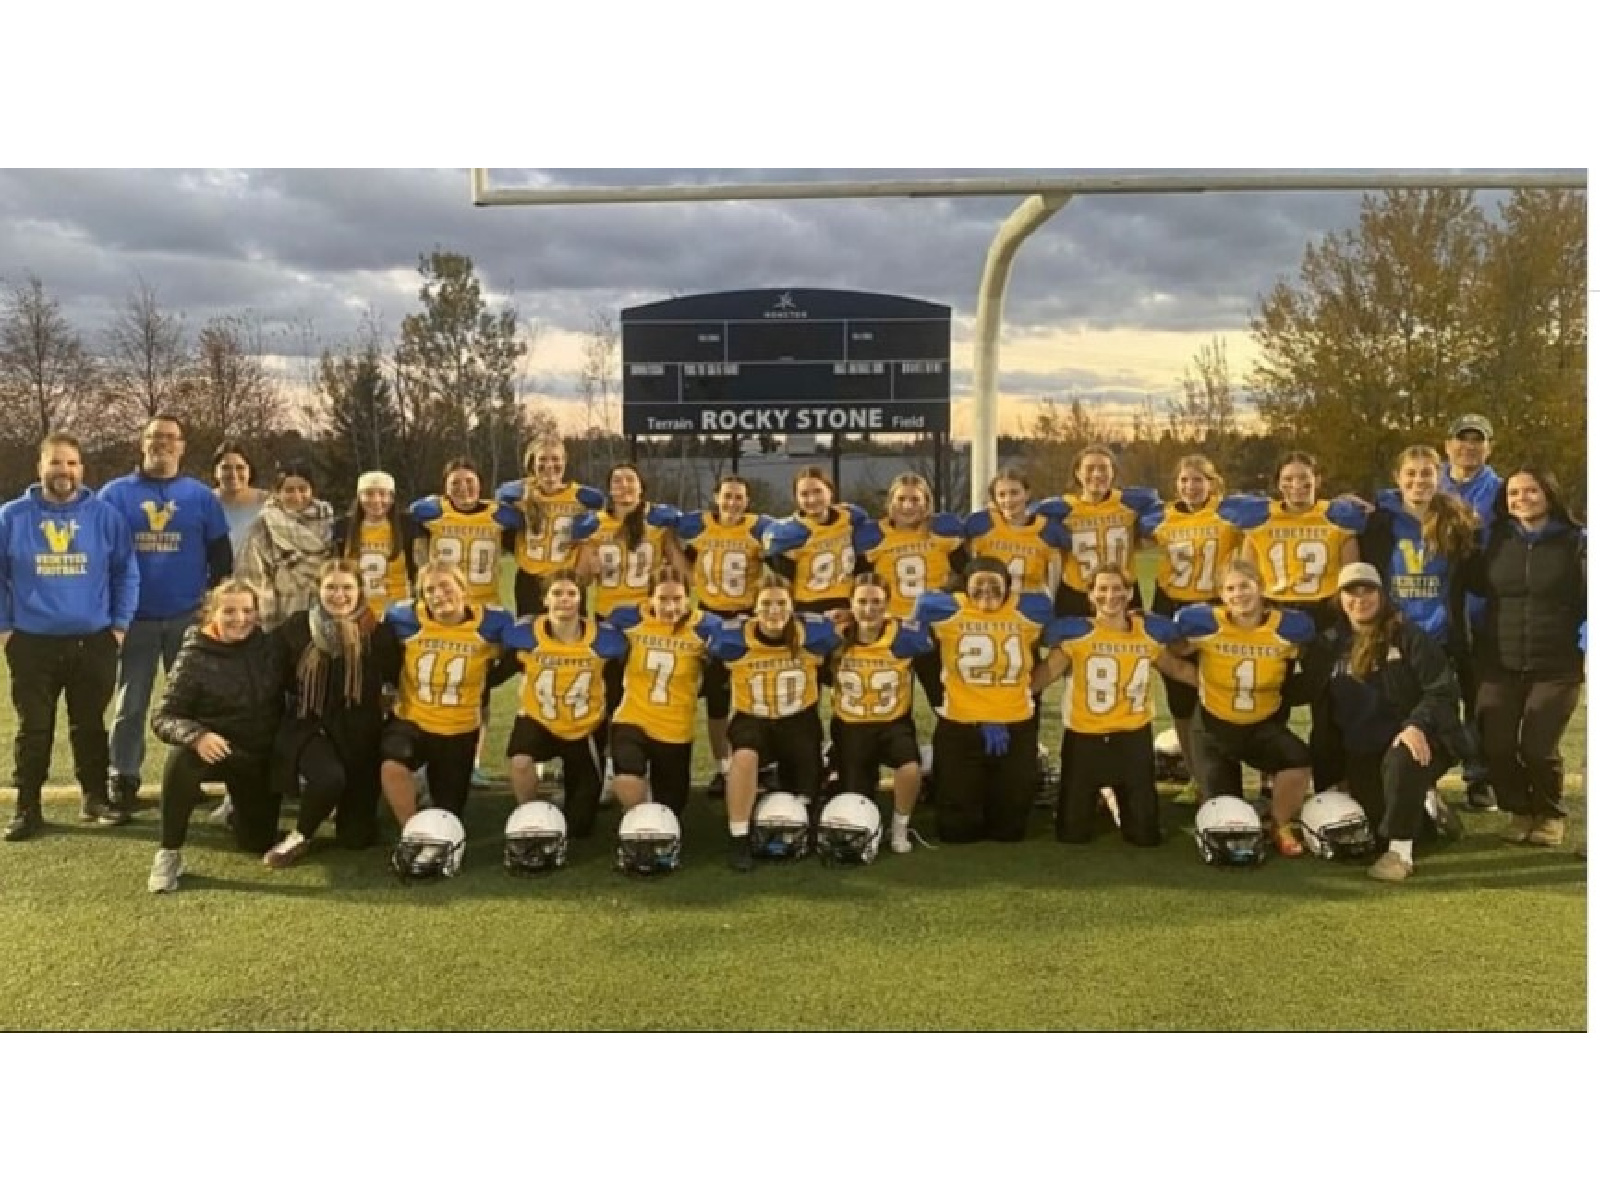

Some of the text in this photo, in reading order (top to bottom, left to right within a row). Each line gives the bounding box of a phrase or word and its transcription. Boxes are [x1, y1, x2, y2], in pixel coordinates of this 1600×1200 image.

[647, 407, 925, 430] Terrain ROCKY STONE Field
[896, 554, 927, 599] 8
[1071, 525, 1131, 580] 50
[1167, 538, 1219, 592] 51
[1268, 540, 1329, 595] 13
[956, 633, 1024, 687] 21
[1090, 642, 1150, 654] VEDETTES
[1214, 642, 1281, 658] VEDETTES
[416, 651, 468, 706] 11
[534, 667, 594, 720] 44
[646, 649, 676, 706] 7
[749, 669, 808, 718] 10
[836, 669, 901, 718] 23
[1085, 653, 1152, 715] 84
[1232, 657, 1256, 713] 1
